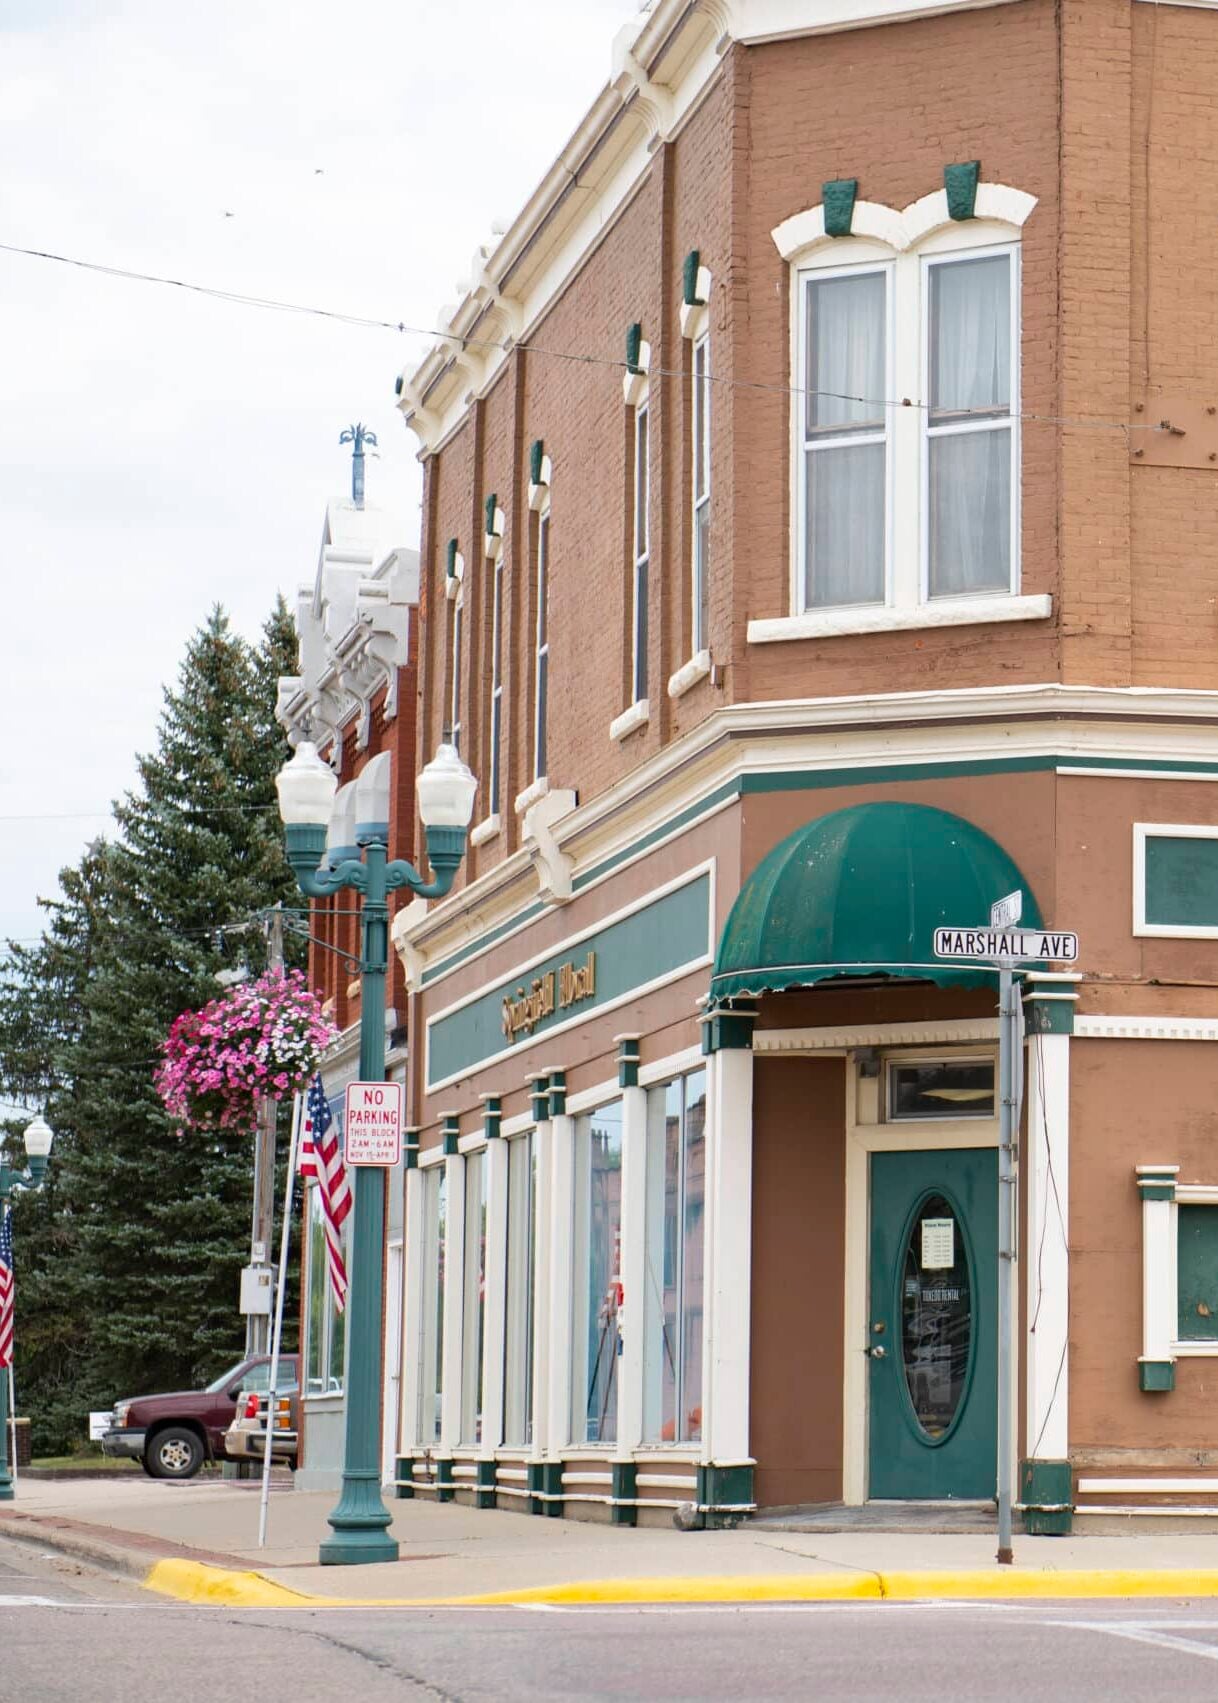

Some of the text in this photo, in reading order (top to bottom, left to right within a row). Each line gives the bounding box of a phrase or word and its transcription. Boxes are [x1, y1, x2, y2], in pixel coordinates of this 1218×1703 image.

[941, 932, 1071, 957] MARSHALL AVE
[364, 1090, 384, 1105] NO
[350, 1110, 397, 1125] PARKING
[351, 1128, 396, 1137] THIS BLOCK
